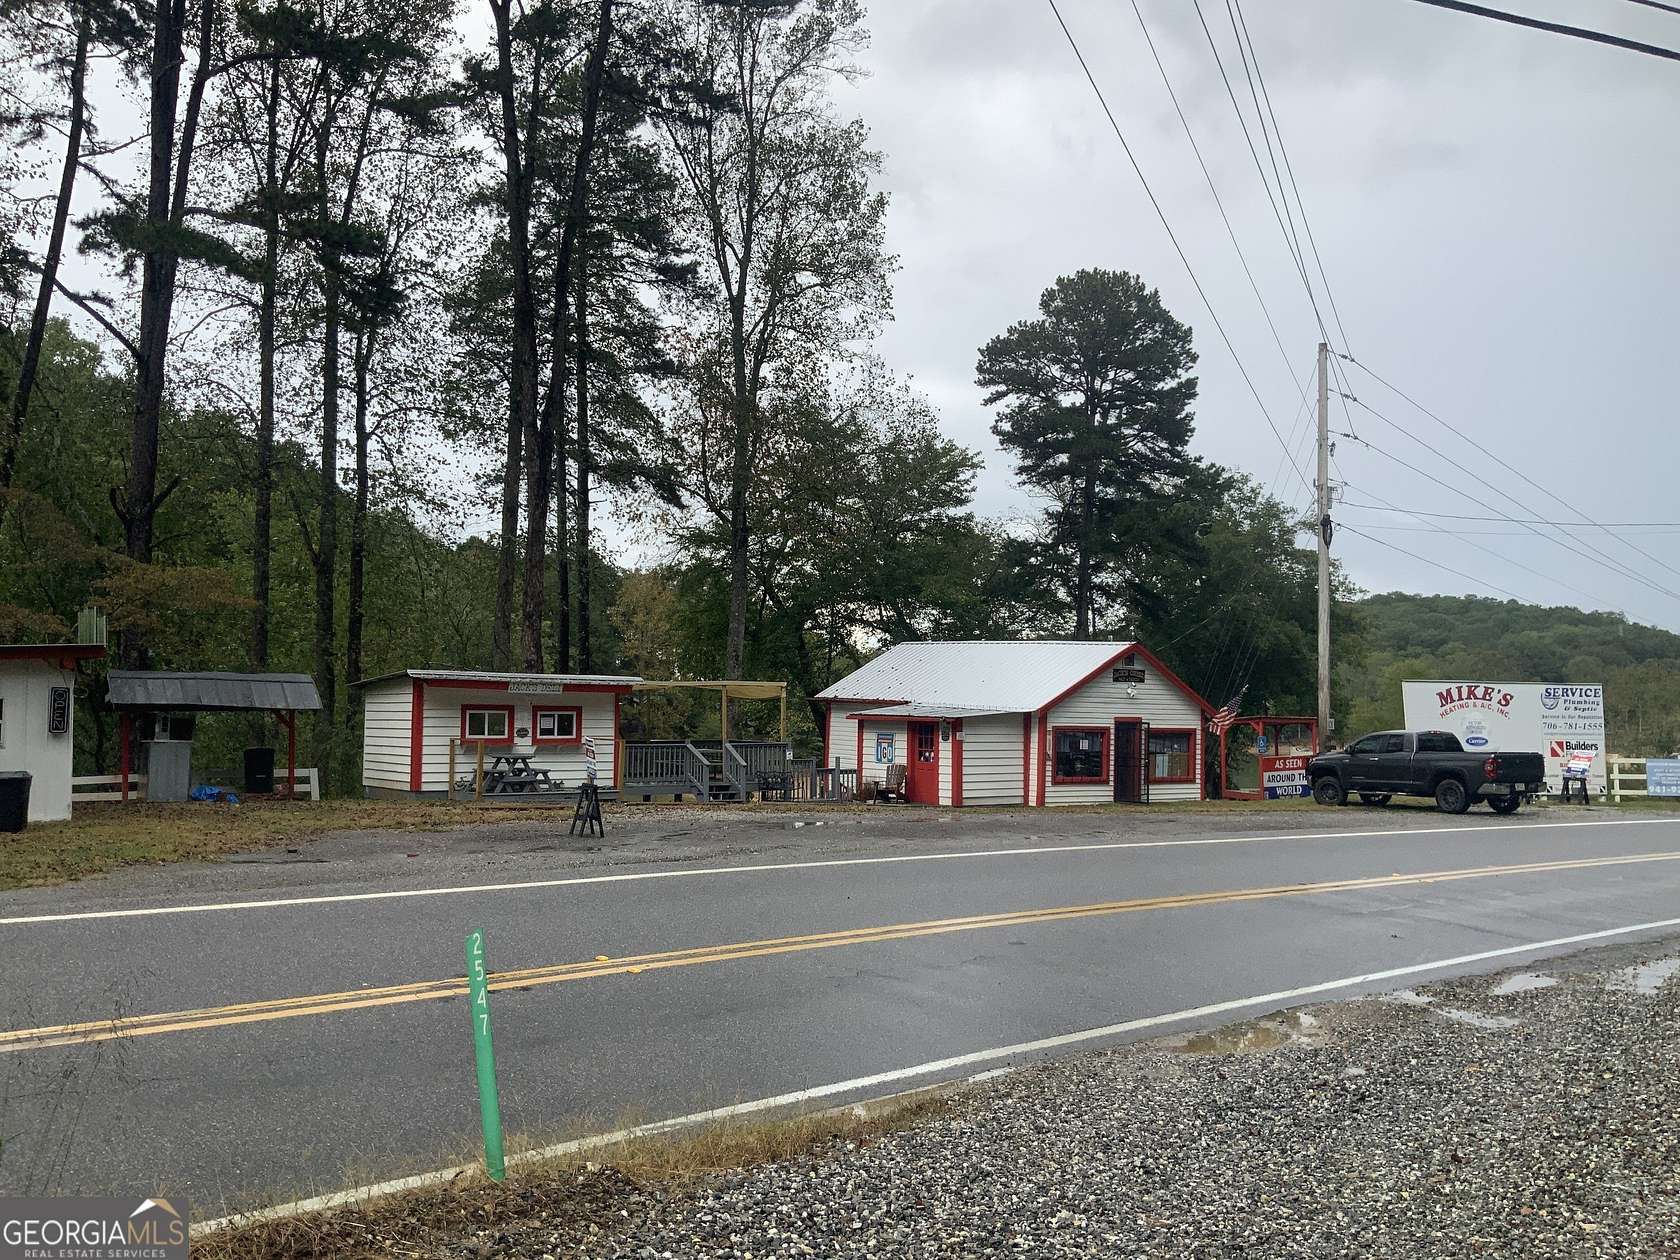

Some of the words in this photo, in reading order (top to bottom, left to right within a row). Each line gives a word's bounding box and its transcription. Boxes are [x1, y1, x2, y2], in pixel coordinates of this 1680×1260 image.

[1436, 685, 1514, 707] MIKE'S
[1544, 687, 1601, 698] SERVICE
[53, 690, 65, 729] OPEN
[1439, 701, 1470, 719] HEATING
[1496, 707, 1511, 720] INC.
[1542, 721, 1603, 730] 706-781-1555
[1565, 741, 1599, 751] Builders
[1275, 760, 1284, 769] AS
[1285, 758, 1302, 768] SEEN
[1266, 773, 1296, 783] AROUND
[1276, 785, 1302, 796] WORLD
[472, 932, 488, 1035] 2547
